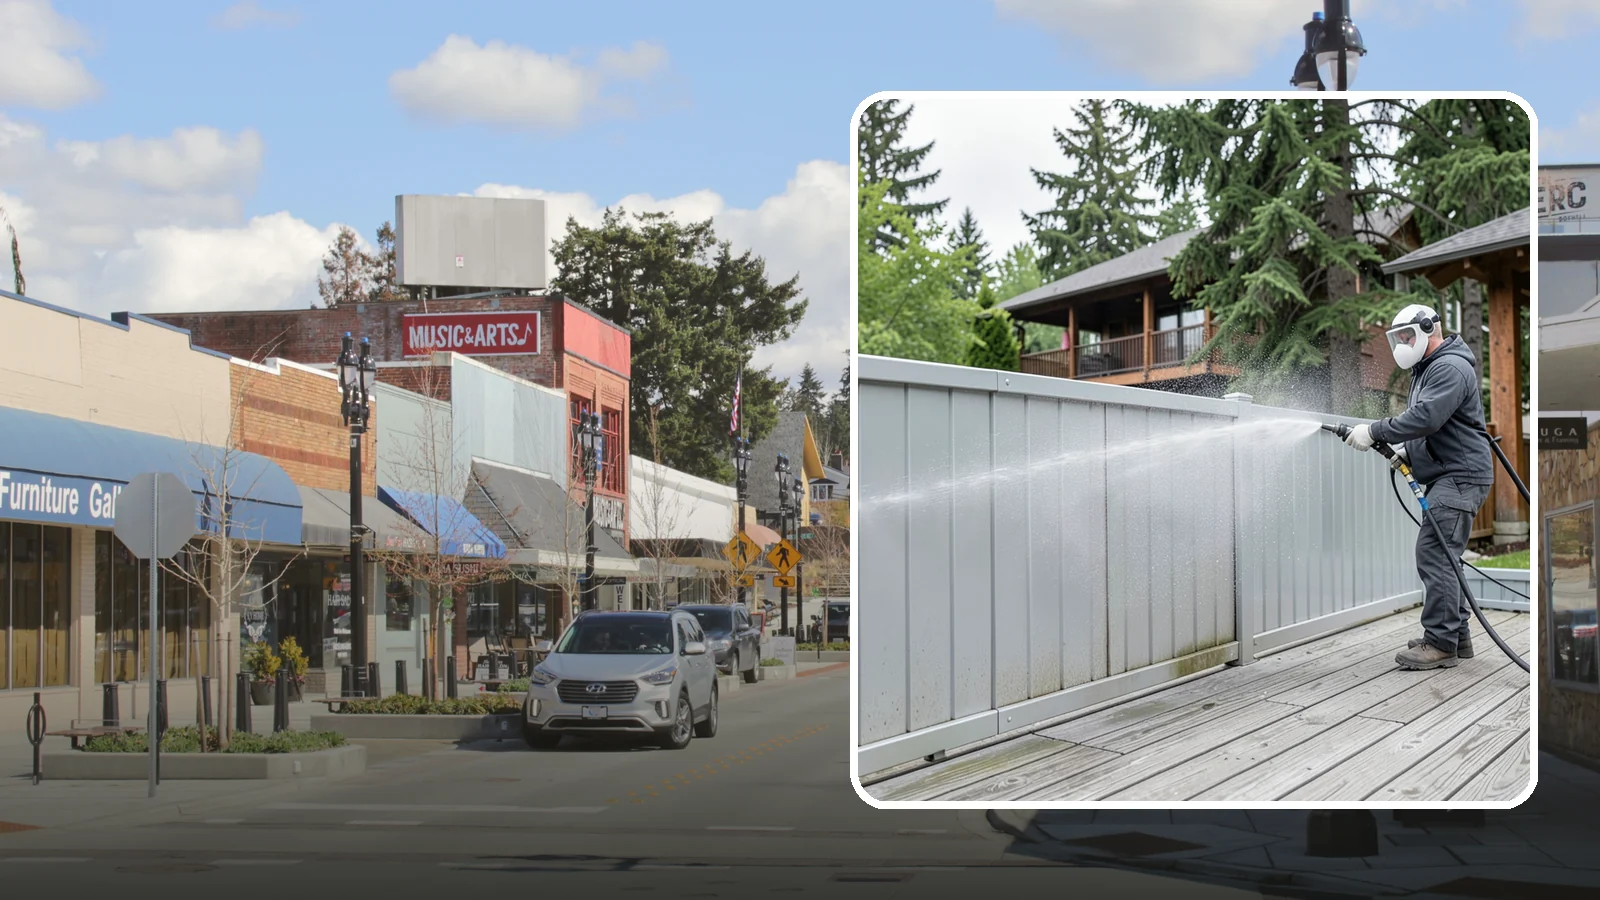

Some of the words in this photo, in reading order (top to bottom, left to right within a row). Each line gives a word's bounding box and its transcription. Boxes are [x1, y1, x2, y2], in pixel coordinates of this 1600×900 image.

[0, 472, 79, 515] Furniture
[90, 483, 121, 518] Gal
[453, 563, 479, 574] SUSHI
